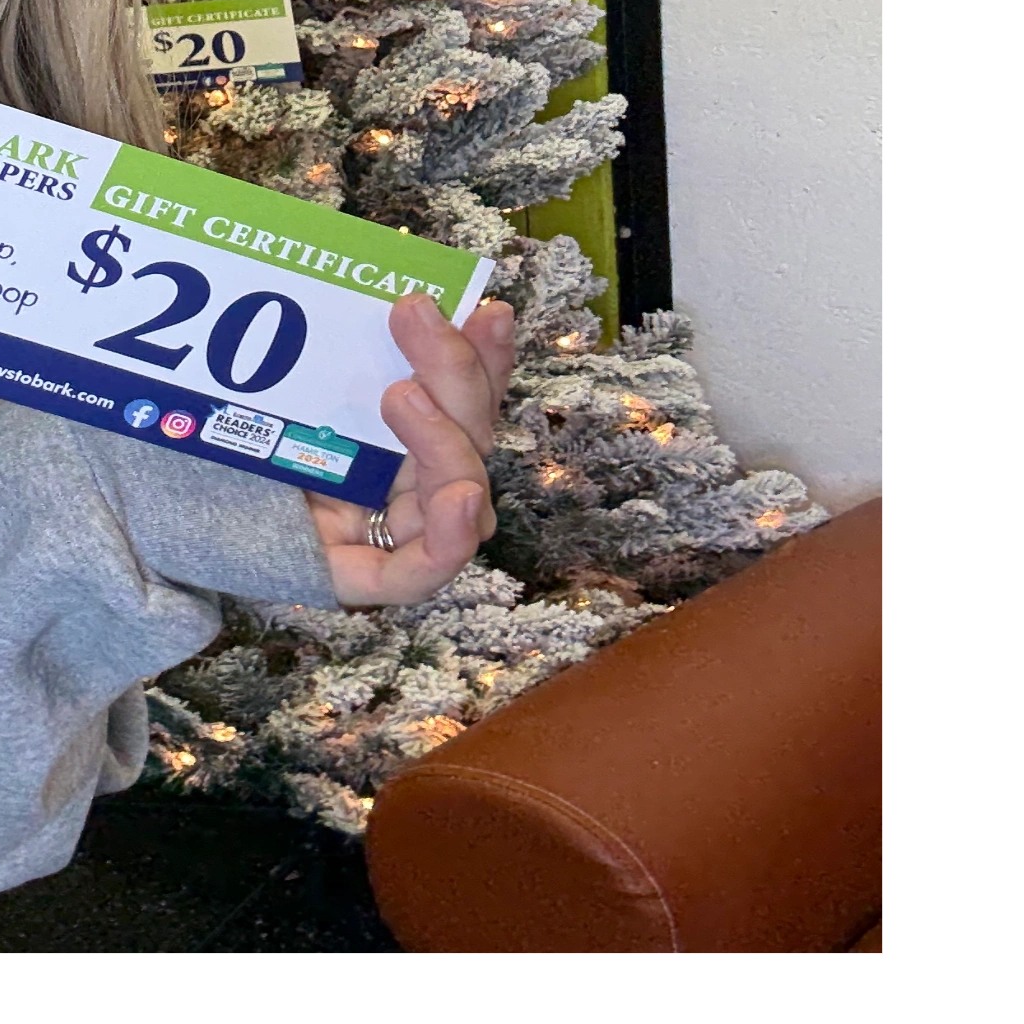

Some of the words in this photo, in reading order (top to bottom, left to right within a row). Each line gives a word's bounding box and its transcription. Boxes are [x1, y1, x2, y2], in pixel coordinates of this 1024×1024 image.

[150, 15, 183, 27] GIFT
[187, 6, 280, 24] CERTIFICATE
[153, 29, 246, 68] $20
[103, 184, 197, 229] GIFT
[66, 223, 308, 395] $20
[212, 423, 249, 439] CHOICE
[249, 433, 271, 446] 2024
[296, 452, 328, 467] 2024
